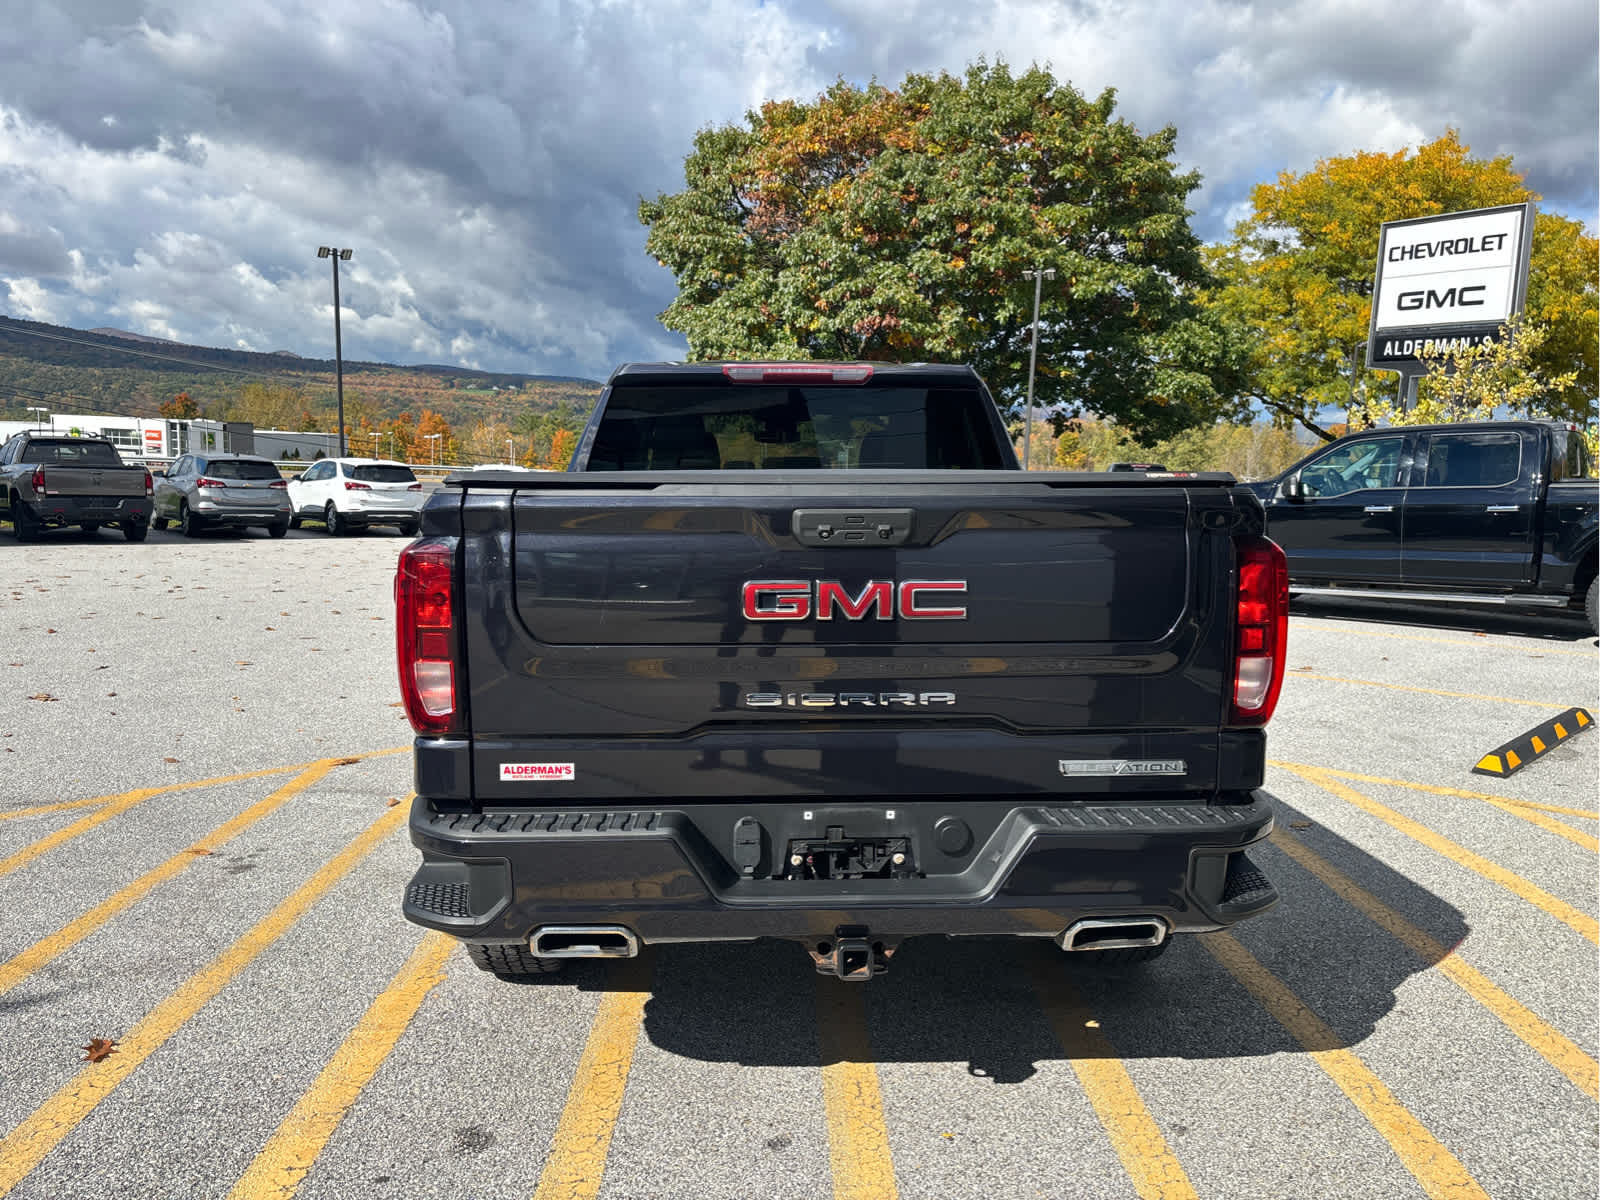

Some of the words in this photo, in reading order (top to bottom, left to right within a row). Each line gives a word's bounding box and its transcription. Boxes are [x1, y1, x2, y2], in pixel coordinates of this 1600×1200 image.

[1388, 233, 1508, 262] CHEVROLET
[1397, 285, 1486, 311] GMC
[742, 579, 968, 620] GMC
[746, 692, 956, 706] SIERRA
[503, 766, 572, 775] ALDERMAN'S
[1062, 761, 1179, 774] ELEVATION
